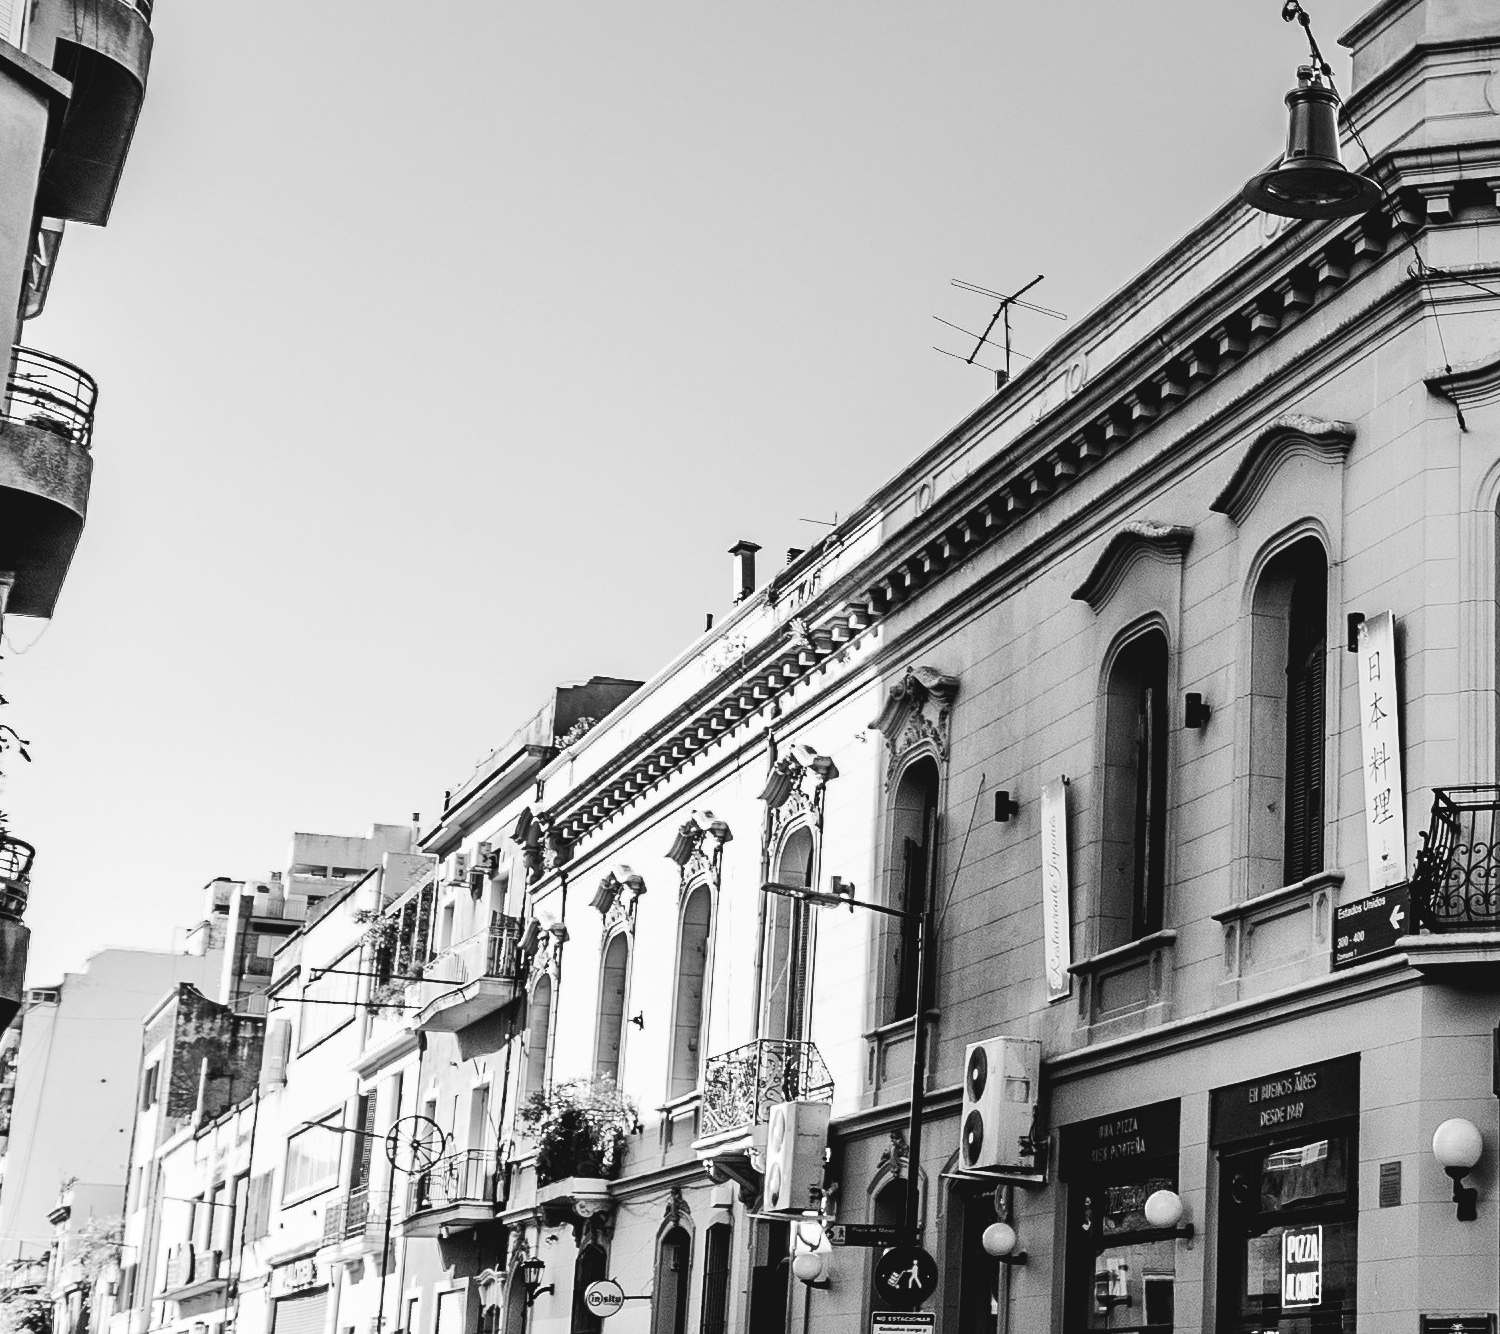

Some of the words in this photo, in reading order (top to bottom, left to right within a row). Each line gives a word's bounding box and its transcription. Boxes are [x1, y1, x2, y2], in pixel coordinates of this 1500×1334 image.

[1368, 651, 1394, 825] 日本料理
[1338, 904, 1362, 919] Estados
[1363, 897, 1386, 911] Unidos
[1048, 884, 1061, 985] Restaurante
[1261, 1079, 1292, 1101] BUENOS
[1260, 1107, 1285, 1127] DESDE
[1287, 1234, 1319, 1263] PIZZA
